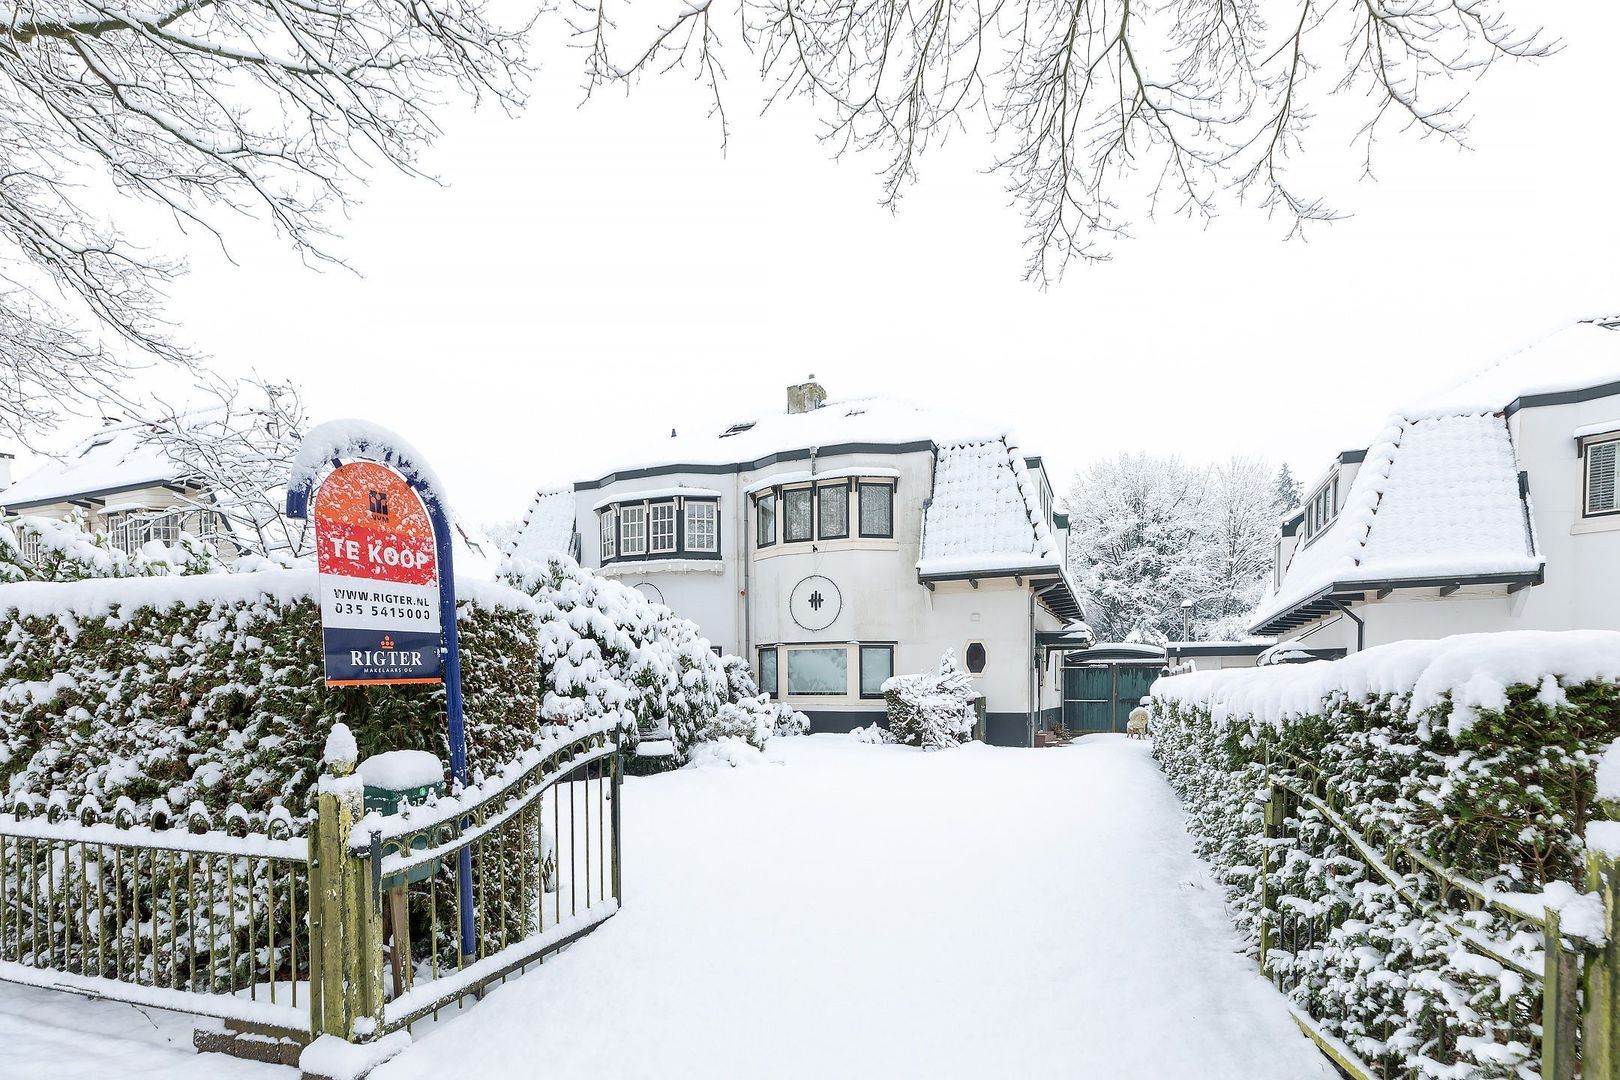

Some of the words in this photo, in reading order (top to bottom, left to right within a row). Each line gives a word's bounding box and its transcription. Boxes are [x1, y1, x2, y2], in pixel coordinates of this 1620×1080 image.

[330, 537, 360, 561] TE
[367, 542, 429, 570] KOOP
[333, 588, 430, 607] WWW.RIGTER.NL
[335, 602, 363, 615] 035
[371, 605, 430, 620] 5415000
[350, 650, 423, 667] RIGTER
